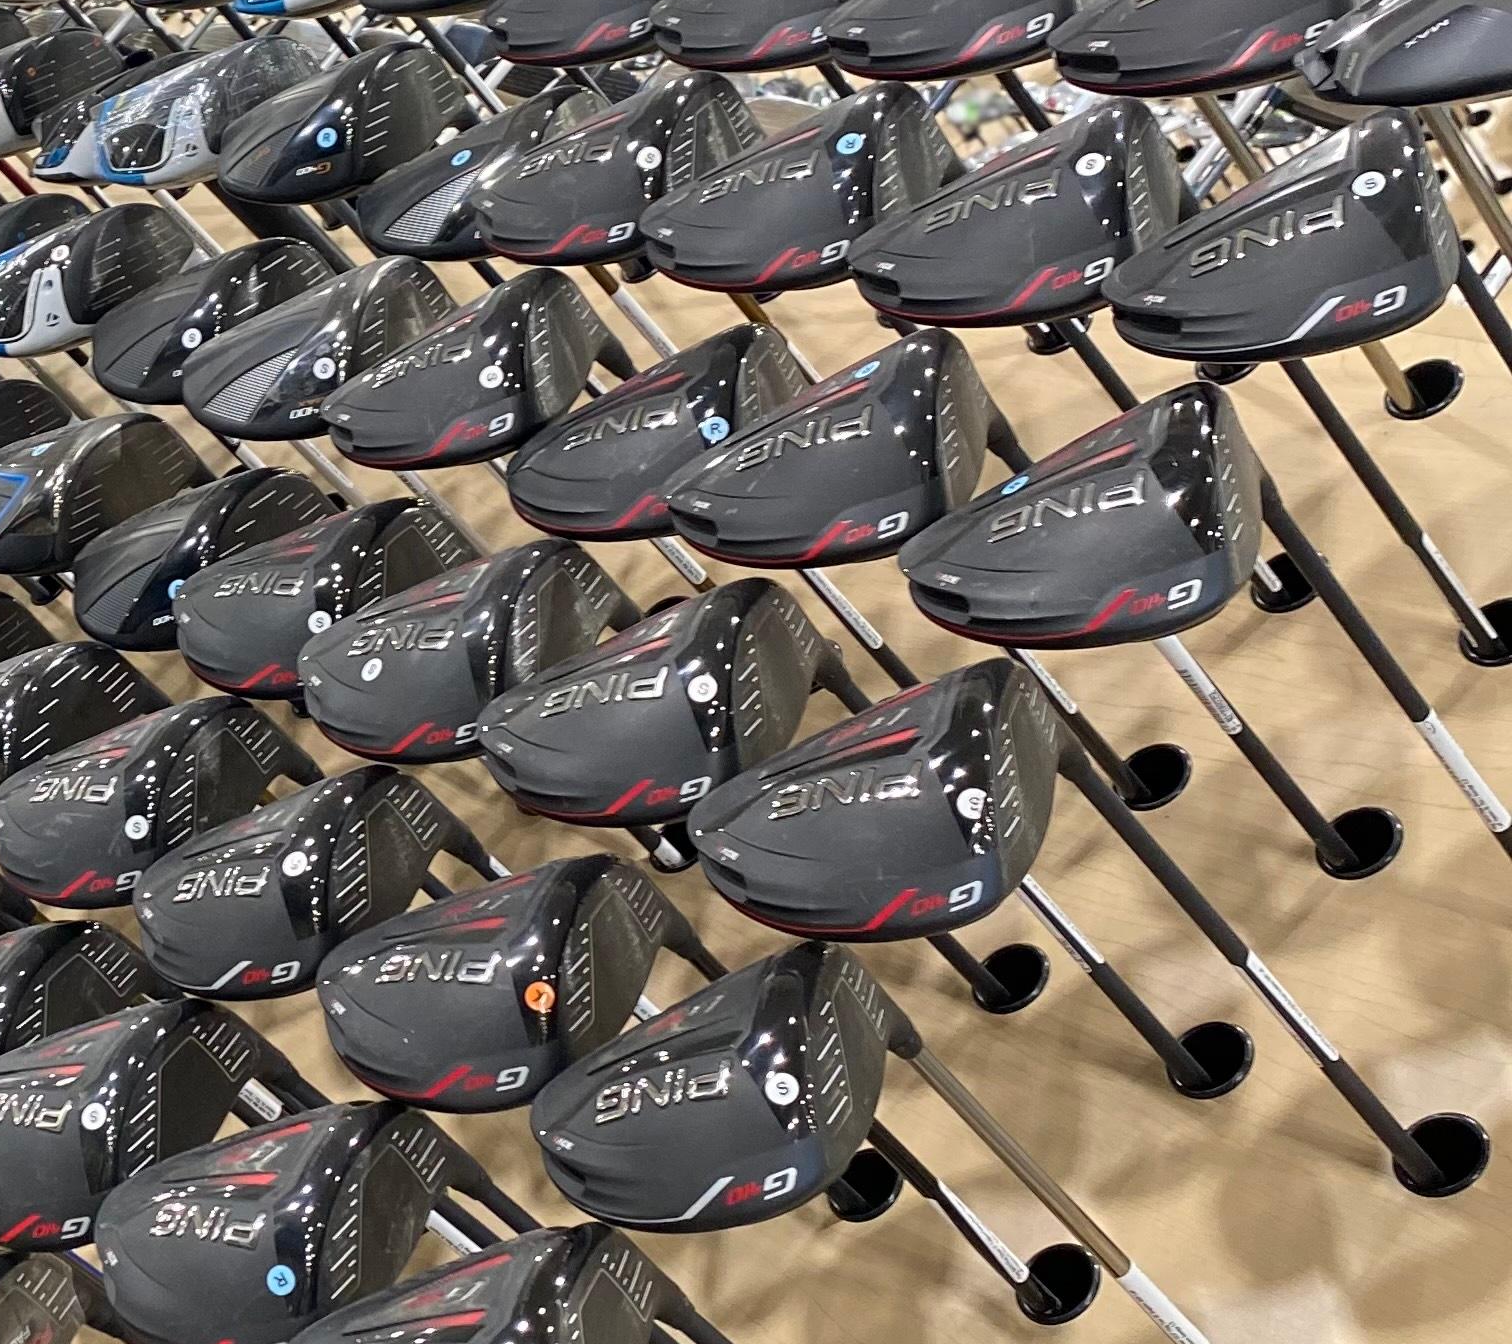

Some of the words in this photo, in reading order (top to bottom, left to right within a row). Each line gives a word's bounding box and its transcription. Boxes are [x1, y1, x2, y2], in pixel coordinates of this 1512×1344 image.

[997, 11, 1055, 50] G410
[518, 136, 621, 178] PING
[699, 151, 821, 203] PING
[1364, 178, 1377, 190] S
[924, 168, 1062, 233] PING
[1189, 194, 1348, 277] PING
[790, 240, 849, 270] G410
[1049, 255, 1116, 293] G410
[1332, 282, 1409, 325] G410
[370, 332, 475, 389] PING
[460, 412, 516, 441] G410
[562, 397, 683, 451] PING
[735, 403, 873, 472] PING
[988, 469, 1149, 544] PING
[843, 510, 910, 546] G410
[213, 566, 310, 598] PING
[1127, 577, 1204, 613] G410
[346, 619, 458, 658] PING
[539, 663, 669, 718] PING
[697, 683, 710, 696] S
[425, 722, 484, 747] G410
[27, 773, 120, 806] PING
[646, 776, 712, 805] G410
[767, 758, 923, 821] PING
[87, 871, 143, 893] G410
[171, 864, 272, 903] PING
[908, 880, 985, 919] G410
[241, 960, 302, 986] G410
[372, 948, 503, 985] PING
[462, 1064, 530, 1093] G410
[594, 1059, 734, 1125] PING
[776, 1081, 789, 1096] S
[723, 1167, 799, 1207] G410
[30, 1214, 92, 1242] G410
[147, 1200, 270, 1249] PING
[273, 1272, 288, 1288] R
